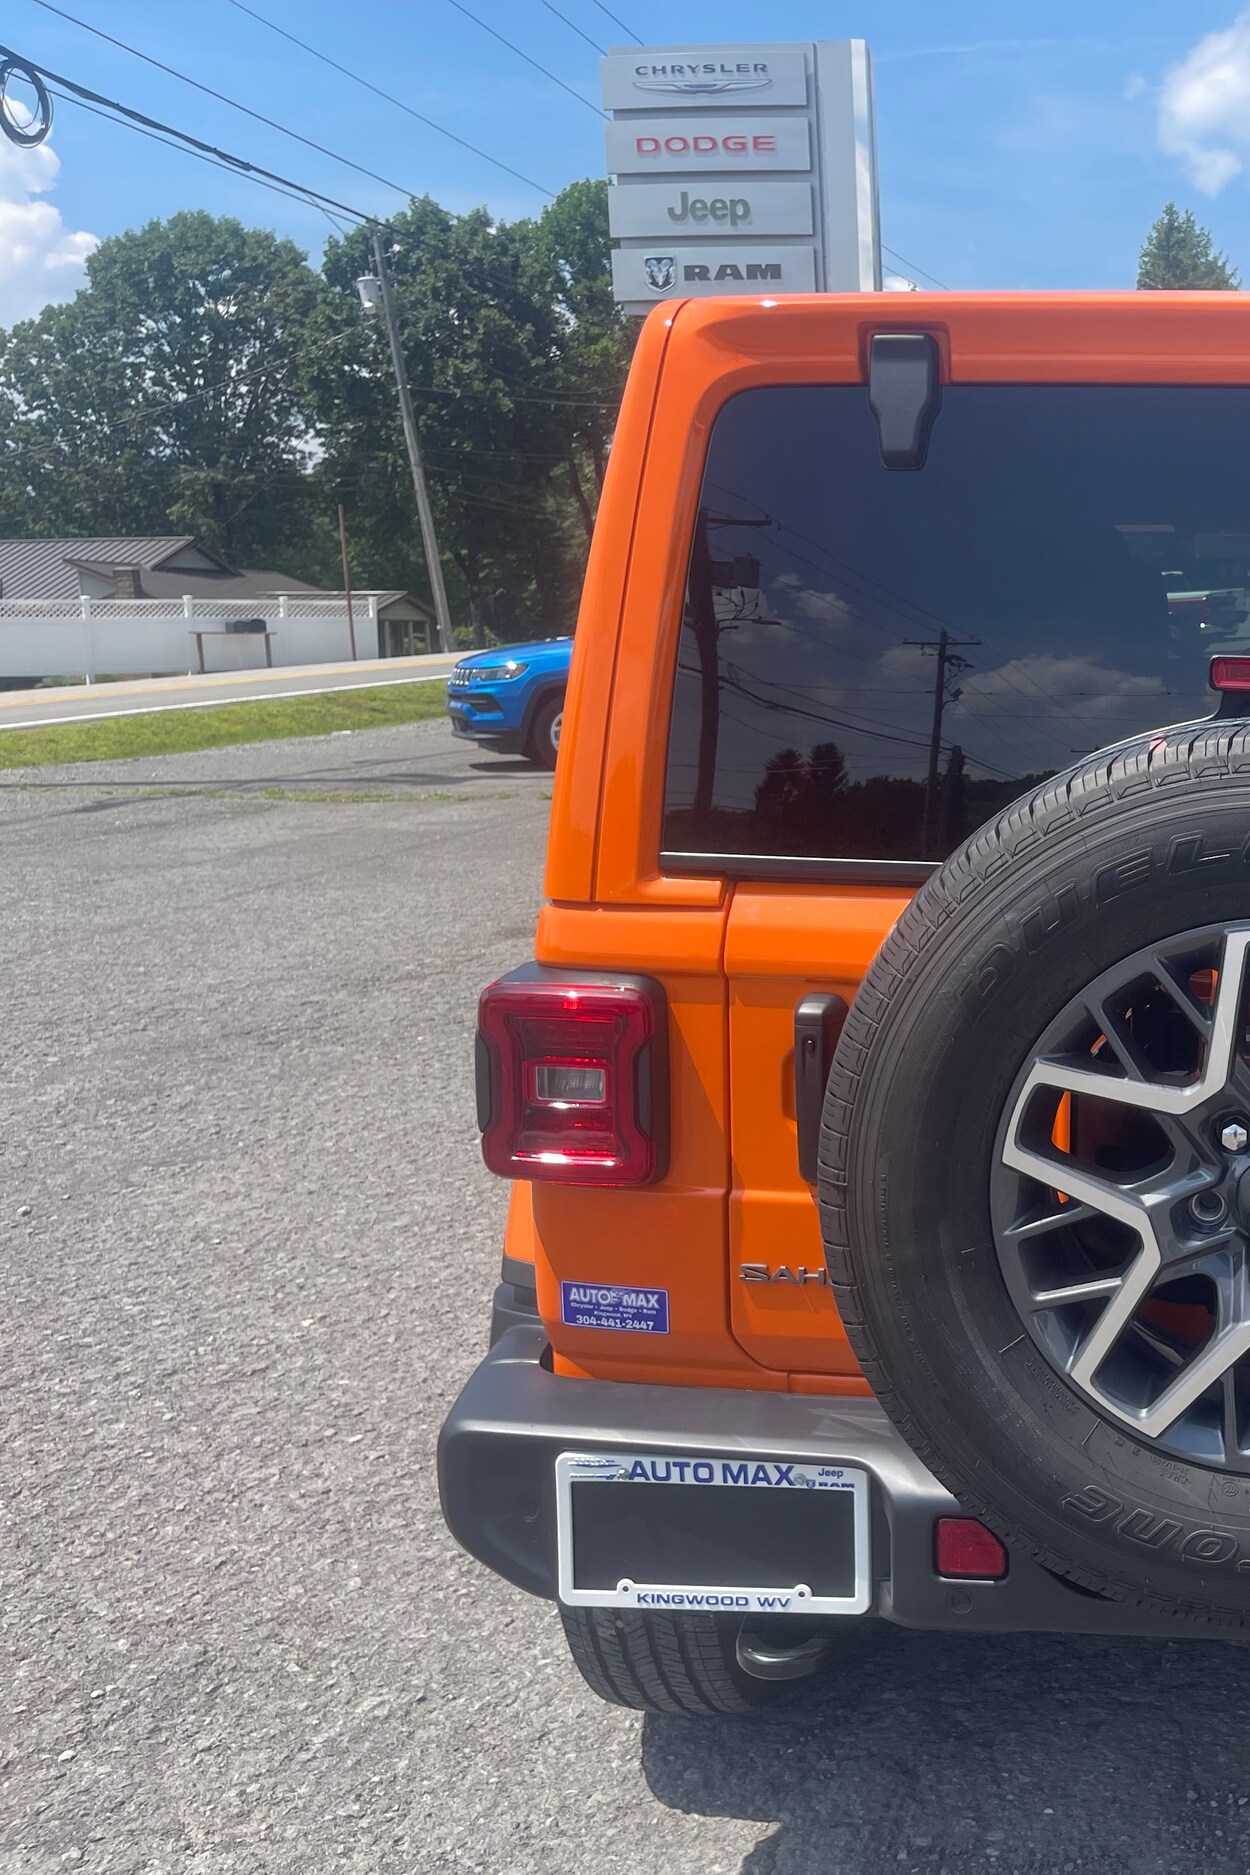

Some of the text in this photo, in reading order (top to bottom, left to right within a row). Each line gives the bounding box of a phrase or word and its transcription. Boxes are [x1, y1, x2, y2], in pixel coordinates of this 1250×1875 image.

[635, 63, 769, 76] CHRYSLER
[636, 135, 776, 153] DODGE
[667, 191, 751, 226] Jeep
[683, 263, 782, 281] RAM
[739, 1263, 829, 1285] SAH
[569, 1287, 660, 1309] AUTO MAX
[576, 1315, 655, 1330] 304-441-2447
[628, 1460, 795, 1486] AUTO MAX
[818, 1468, 844, 1479] Jeep
[636, 1593, 791, 1608] KINGWOOD WV
